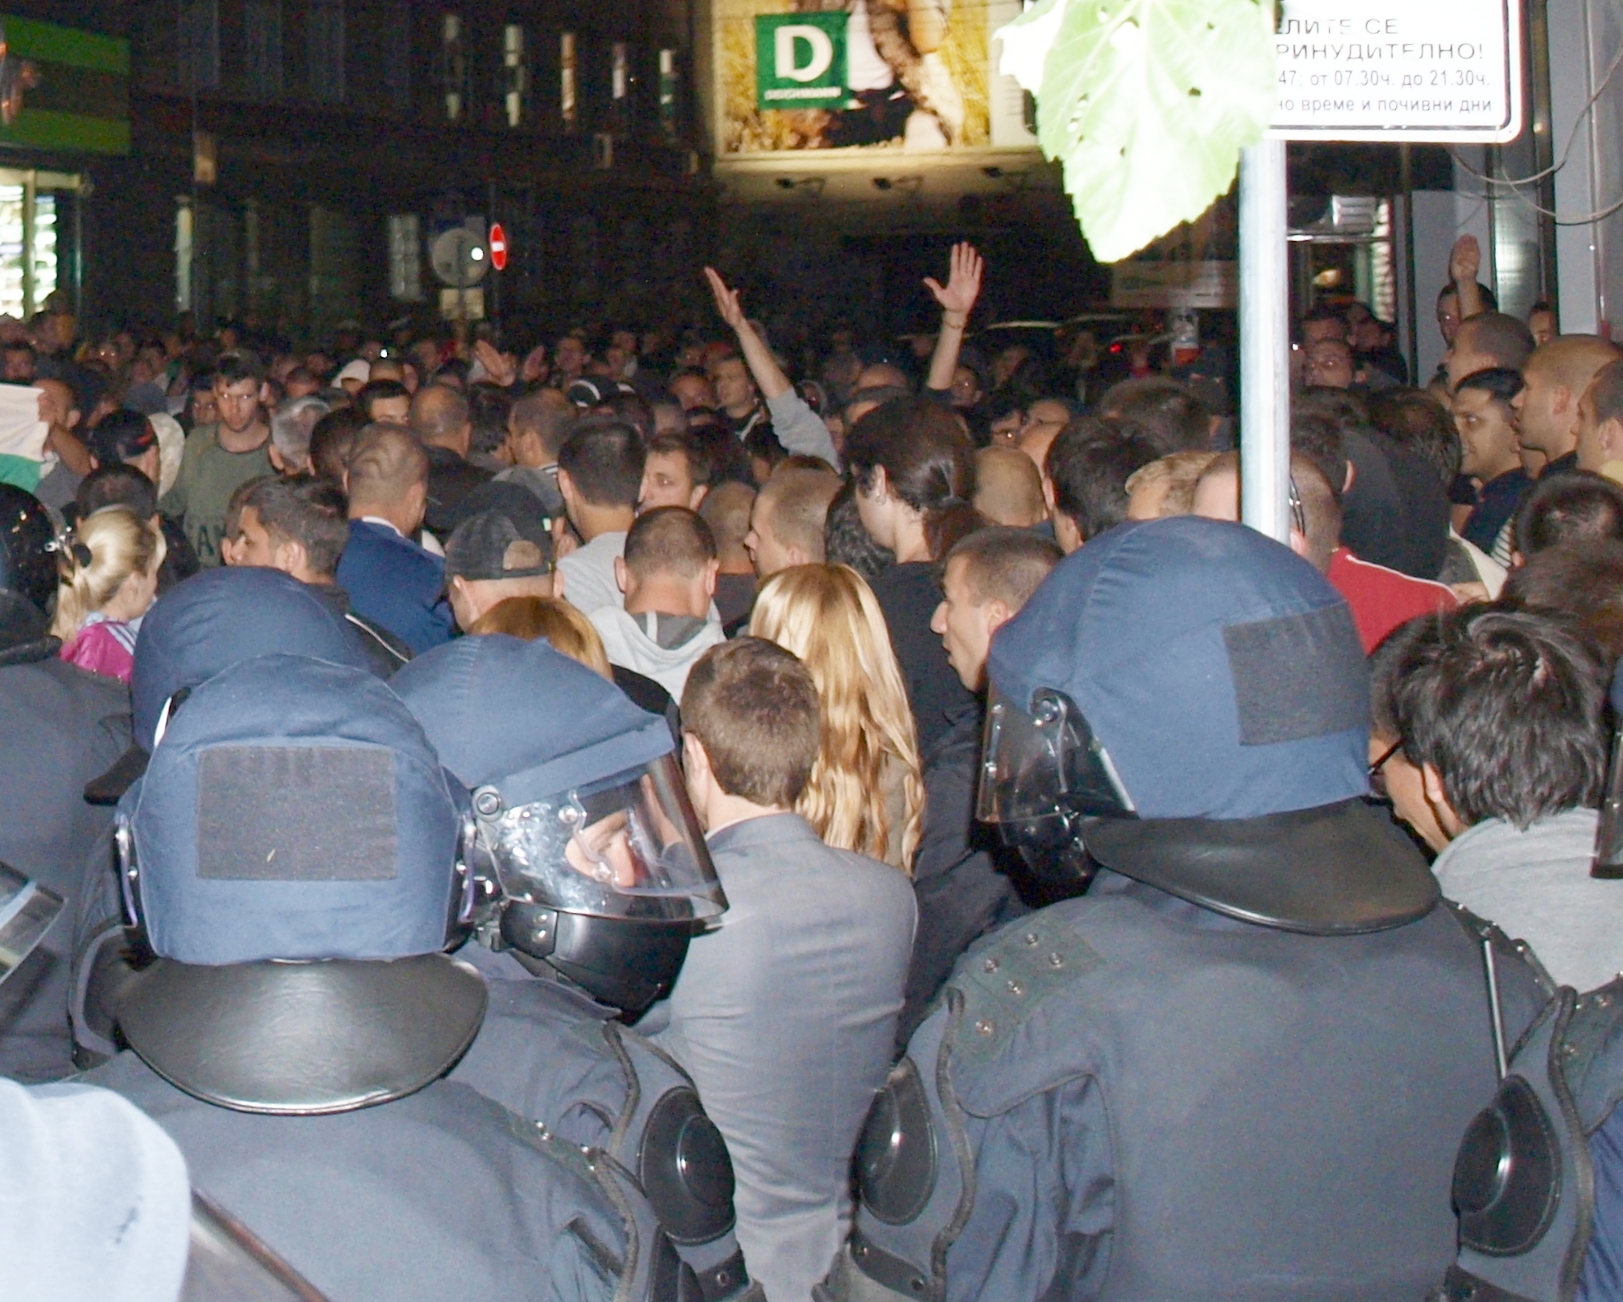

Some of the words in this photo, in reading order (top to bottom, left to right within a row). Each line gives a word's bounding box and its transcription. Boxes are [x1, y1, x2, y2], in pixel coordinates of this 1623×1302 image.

[1364, 18, 1399, 35] СЕ
[774, 24, 834, 83] D
[1310, 74, 1328, 86] от
[1334, 70, 1395, 86] 07.30ч.
[1401, 74, 1423, 89] до
[1429, 69, 1491, 86] 21.30ч.
[1301, 99, 1355, 115] време
[1361, 100, 1371, 111] и
[1378, 99, 1453, 112] почивни
[1459, 100, 1493, 113] дни
